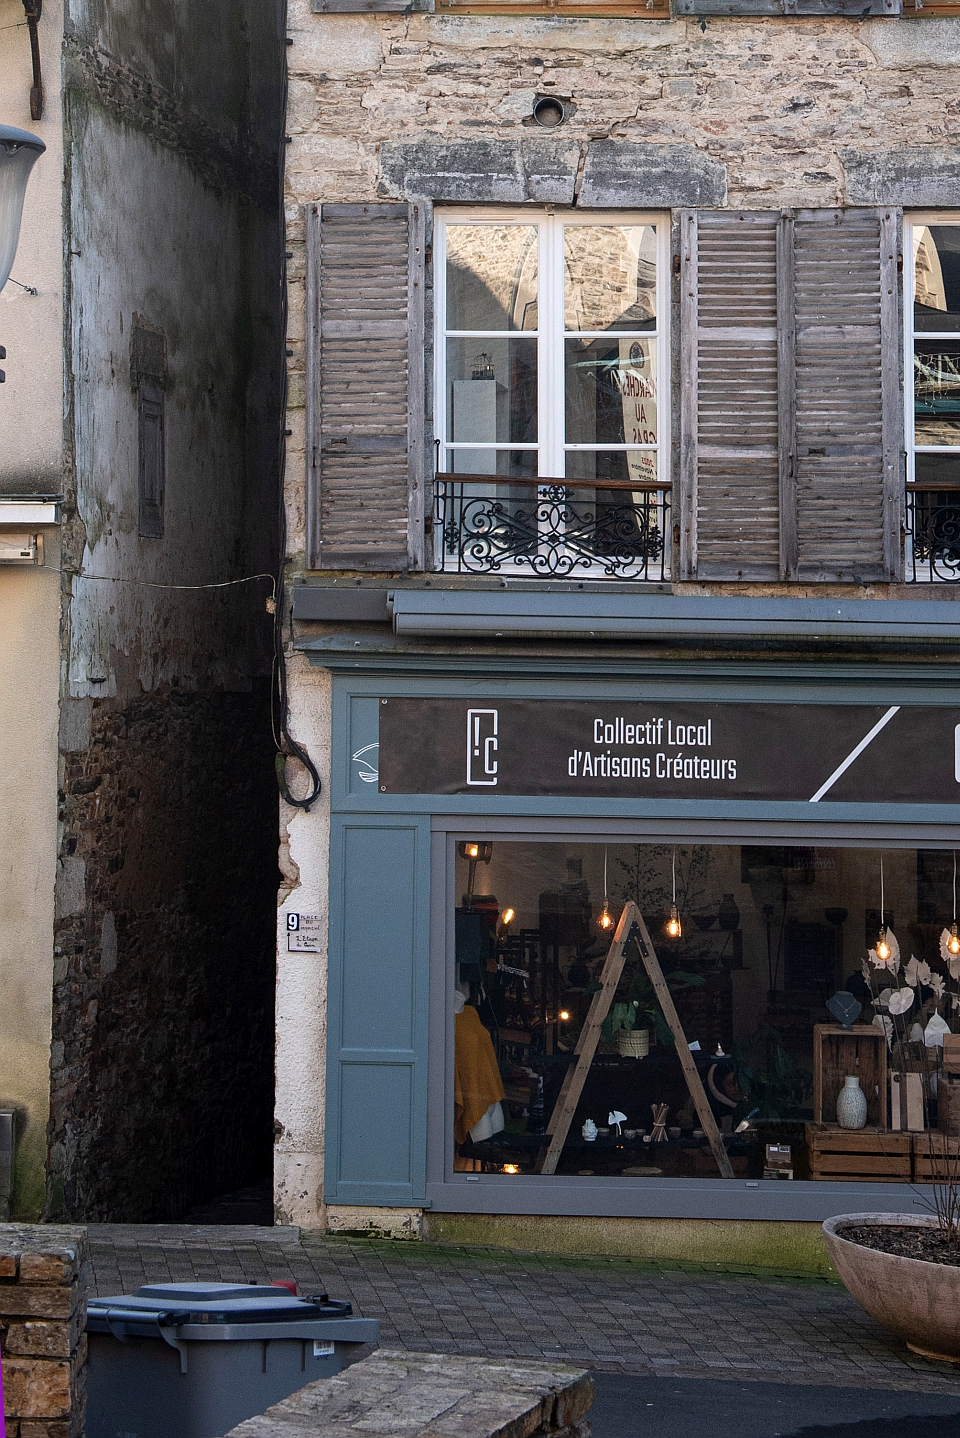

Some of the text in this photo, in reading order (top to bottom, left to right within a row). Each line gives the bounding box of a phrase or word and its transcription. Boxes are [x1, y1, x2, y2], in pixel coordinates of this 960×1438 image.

[593, 718, 712, 747] Collectif Local
[568, 751, 737, 780] d'Artisans Créateurs
[288, 914, 298, 930] 9
